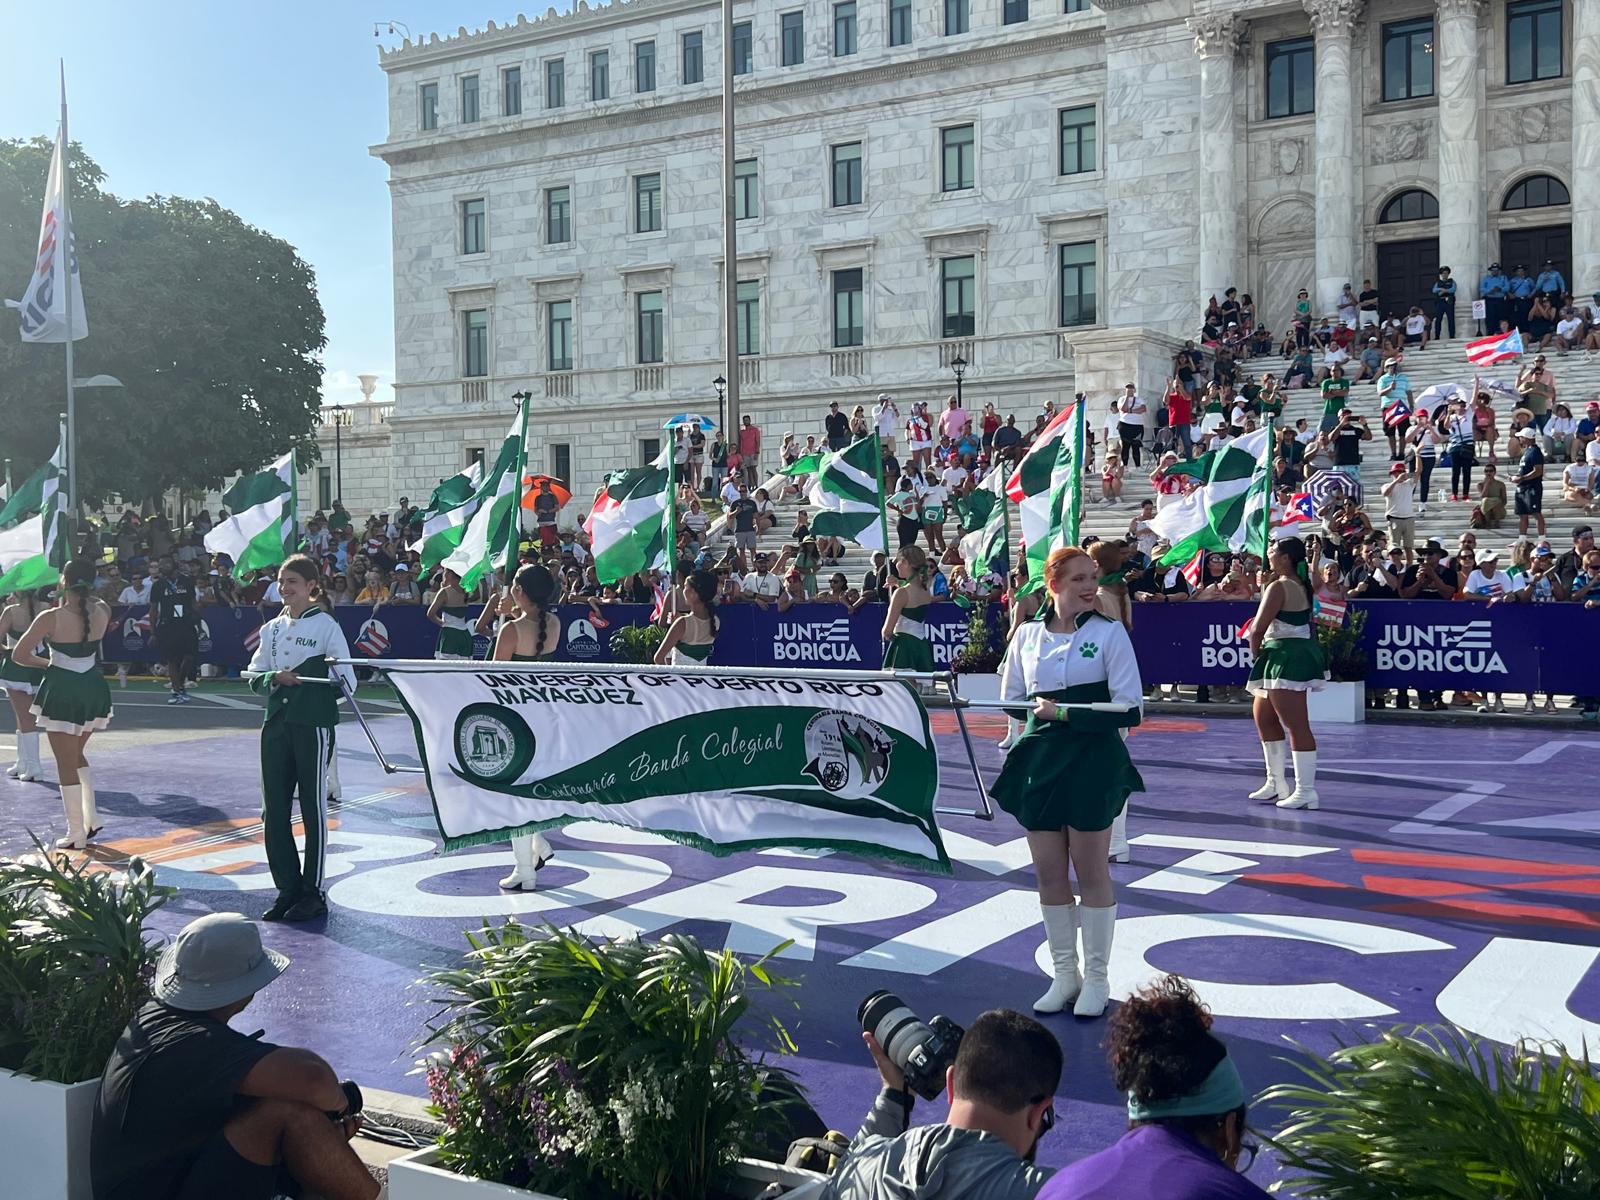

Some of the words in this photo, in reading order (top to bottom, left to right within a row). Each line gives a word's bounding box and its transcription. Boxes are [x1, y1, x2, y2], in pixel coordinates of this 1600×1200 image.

[295, 636, 317, 649] RUM
[773, 642, 862, 662] BORICUA
[1376, 649, 1509, 674] BORICUA
[475, 673, 633, 689] UNIVERSITY
[637, 674, 678, 688] OF
[680, 676, 804, 694] PUERTO
[804, 680, 884, 698] RICO
[491, 686, 643, 706] MAYAGÜEZ
[532, 770, 617, 800] Centenaria
[628, 734, 691, 783] Banda
[701, 722, 784, 766] Colegial
